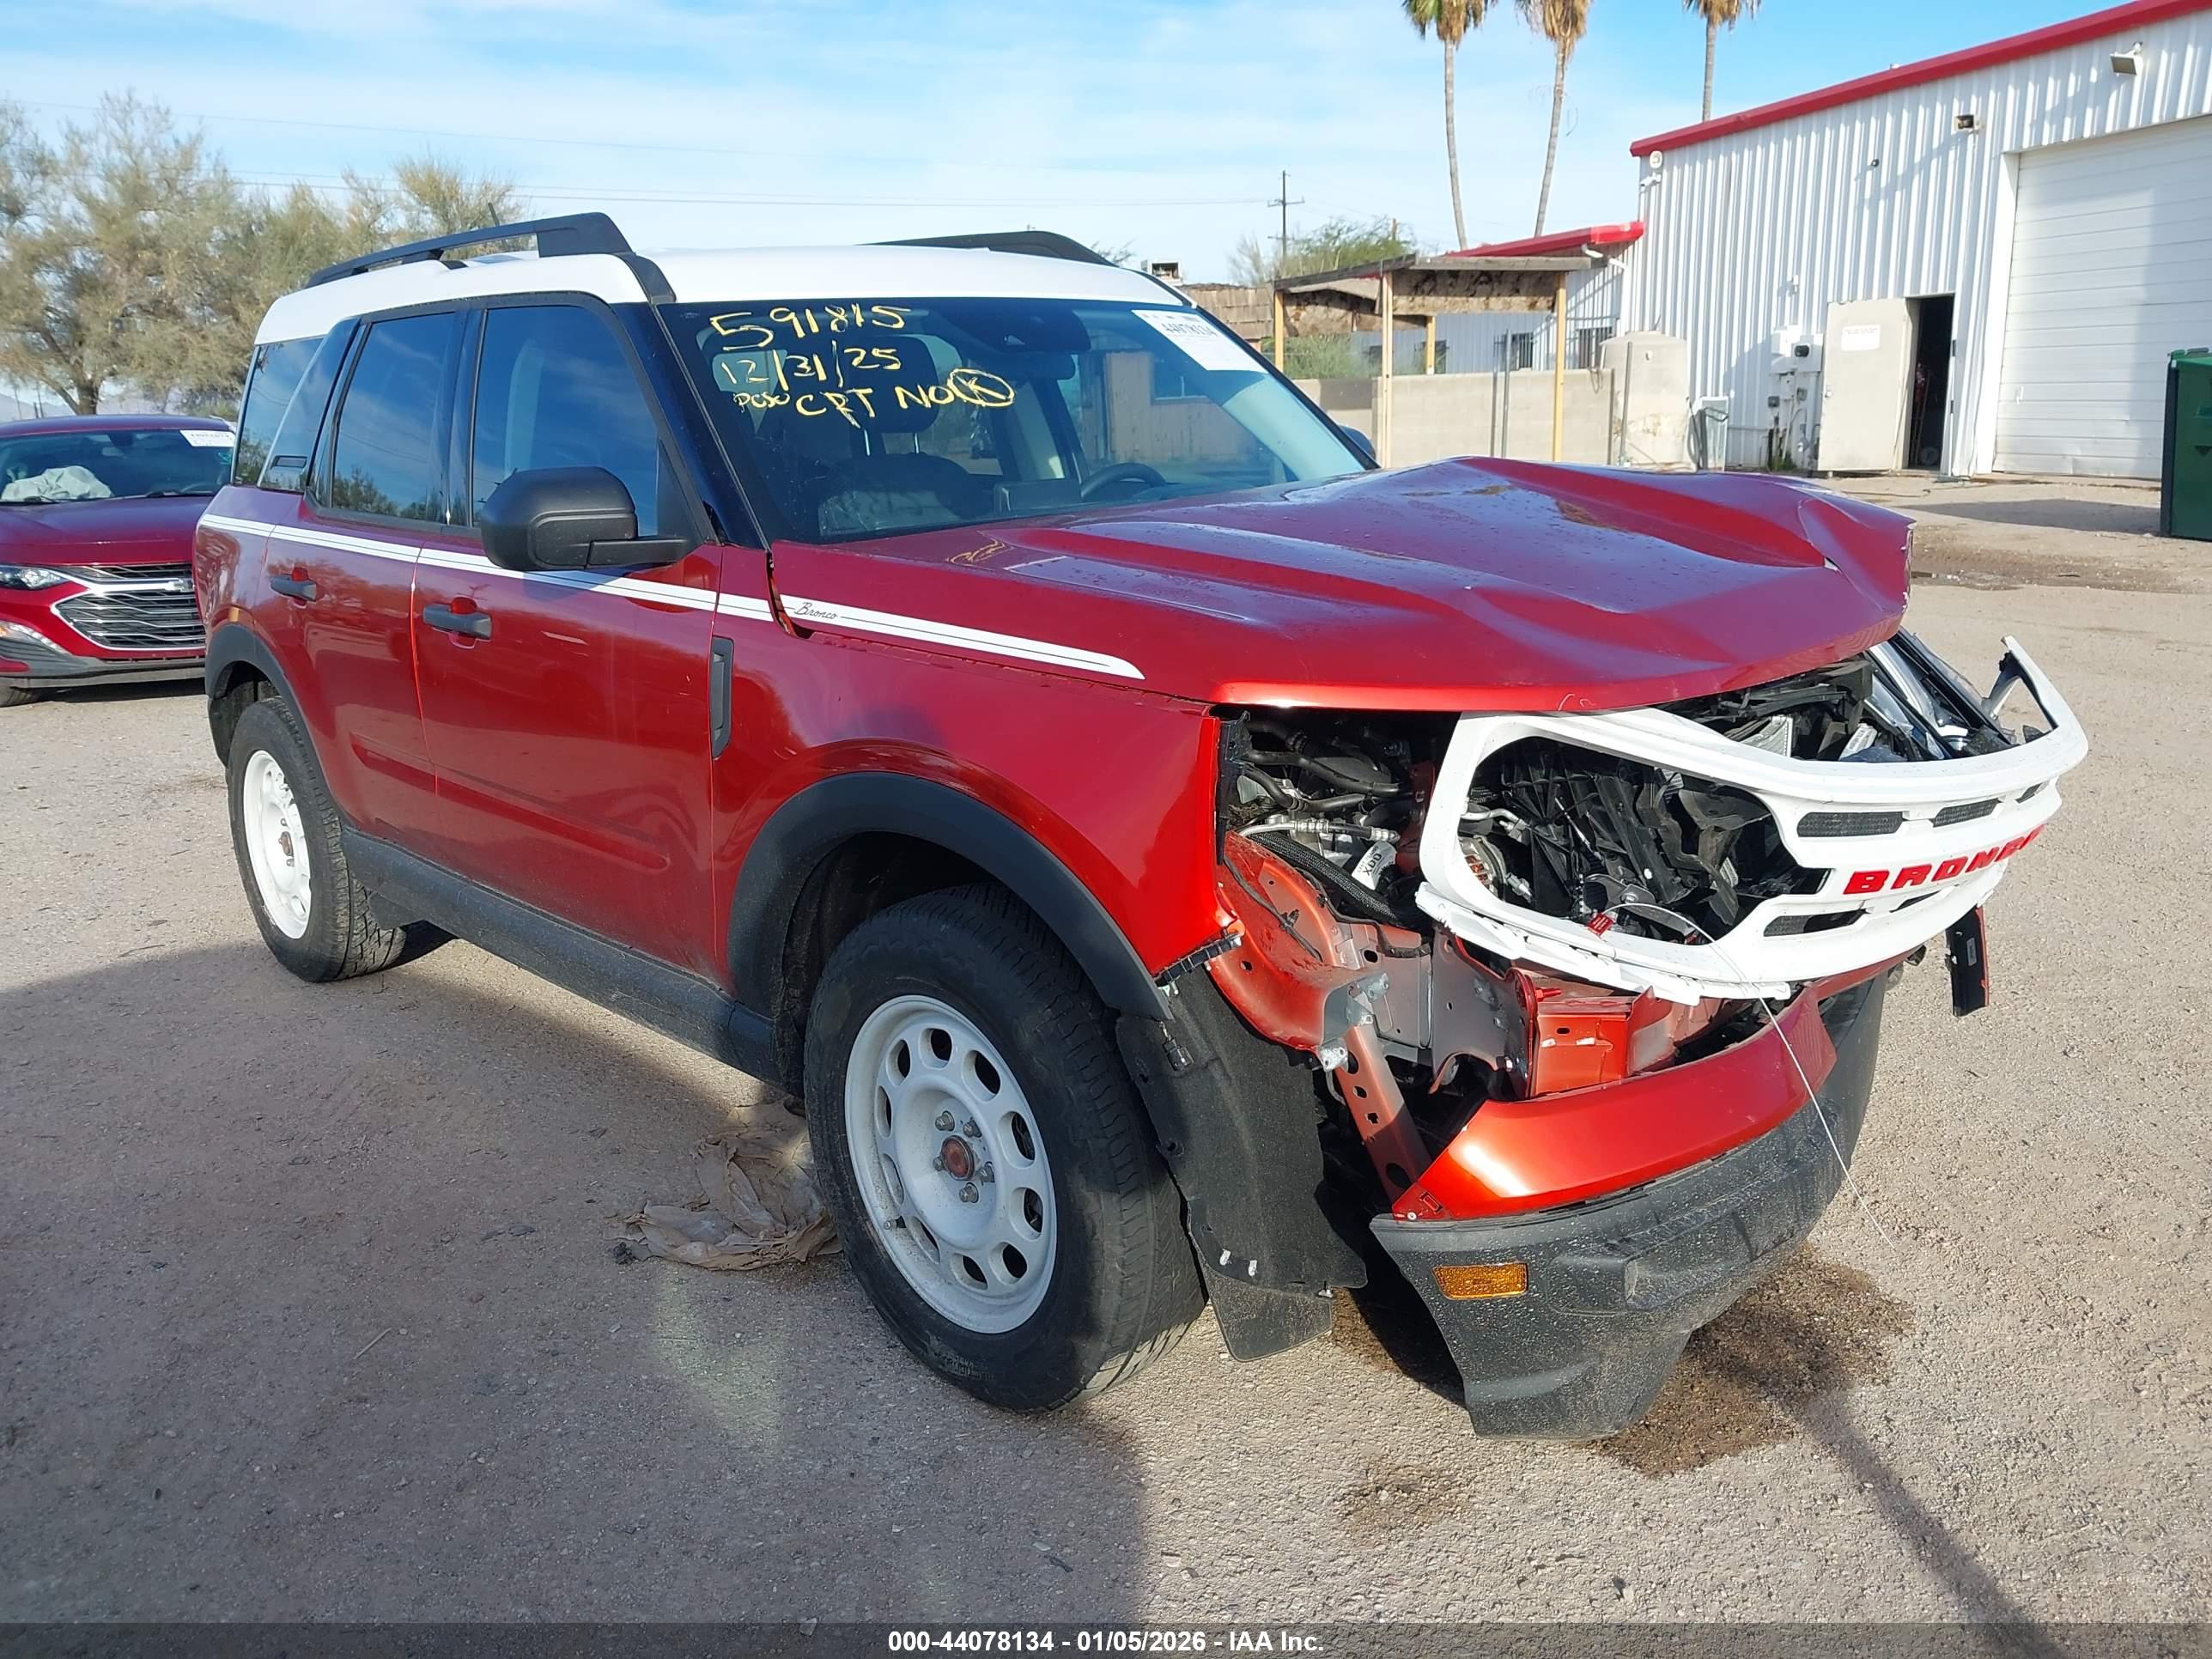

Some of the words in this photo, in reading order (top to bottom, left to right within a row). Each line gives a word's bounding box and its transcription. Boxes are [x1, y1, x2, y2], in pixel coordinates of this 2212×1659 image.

[710, 303, 912, 351] 591815
[721, 339, 902, 391] 12/31/25
[793, 602, 838, 619] Bronco
